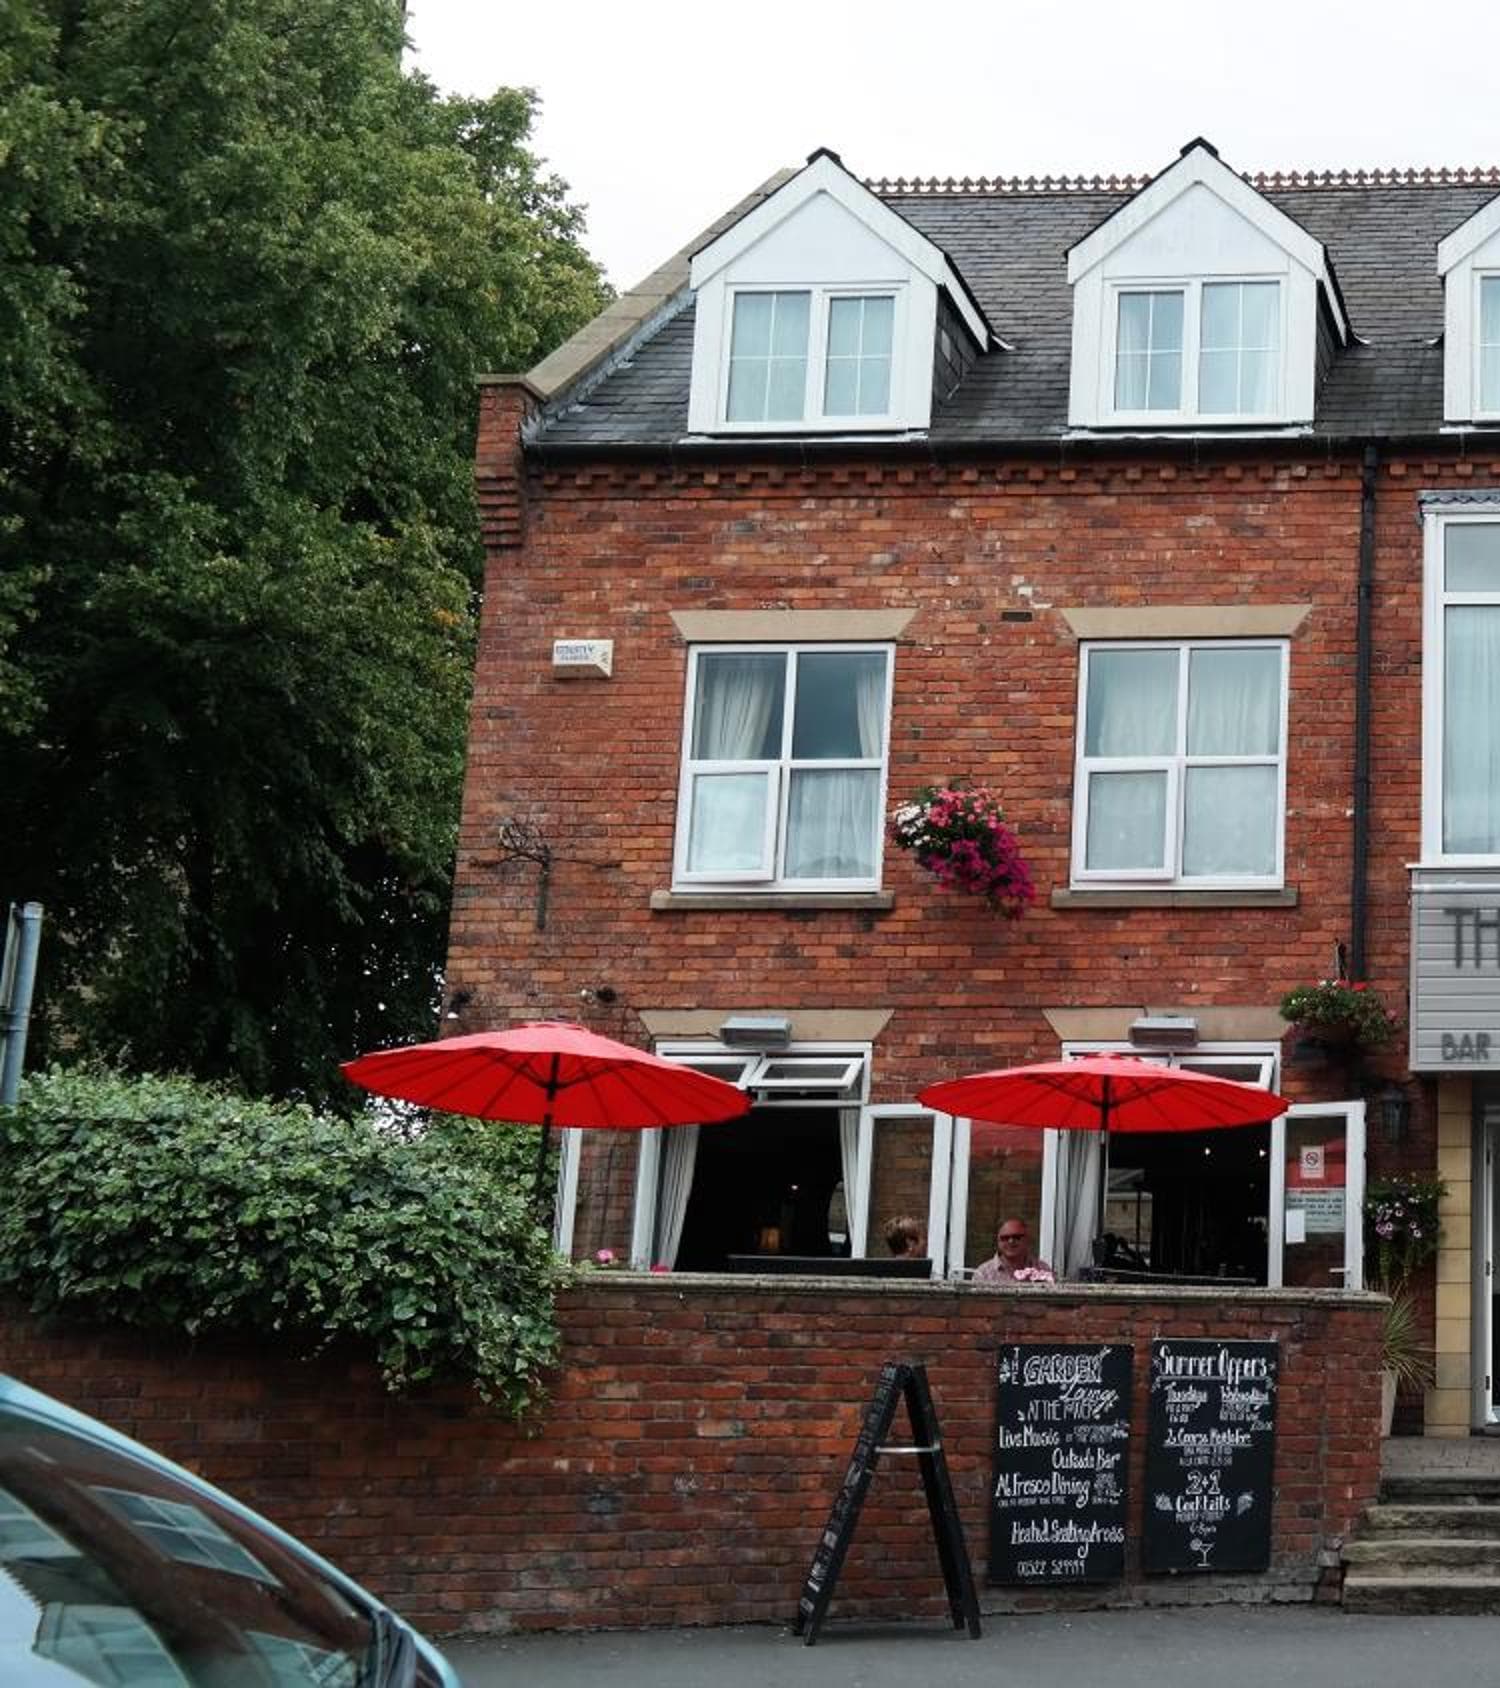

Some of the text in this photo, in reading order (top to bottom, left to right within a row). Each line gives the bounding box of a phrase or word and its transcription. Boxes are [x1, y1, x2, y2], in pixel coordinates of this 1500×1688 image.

[1441, 1033, 1491, 1061] BAR
[1023, 1354, 1103, 1386] GARDEN
[1160, 1344, 1267, 1385] Summer Offers
[1043, 1400, 1062, 1420] THE
[999, 1425, 1022, 1448] Live
[1023, 1424, 1060, 1447] Music
[1052, 1448, 1120, 1470] Outside Bar
[1013, 1472, 1050, 1496] Fresco
[1051, 1472, 1090, 1509] Dining
[1176, 1495, 1231, 1512] Cocktails
[1051, 1519, 1092, 1558] Seating
